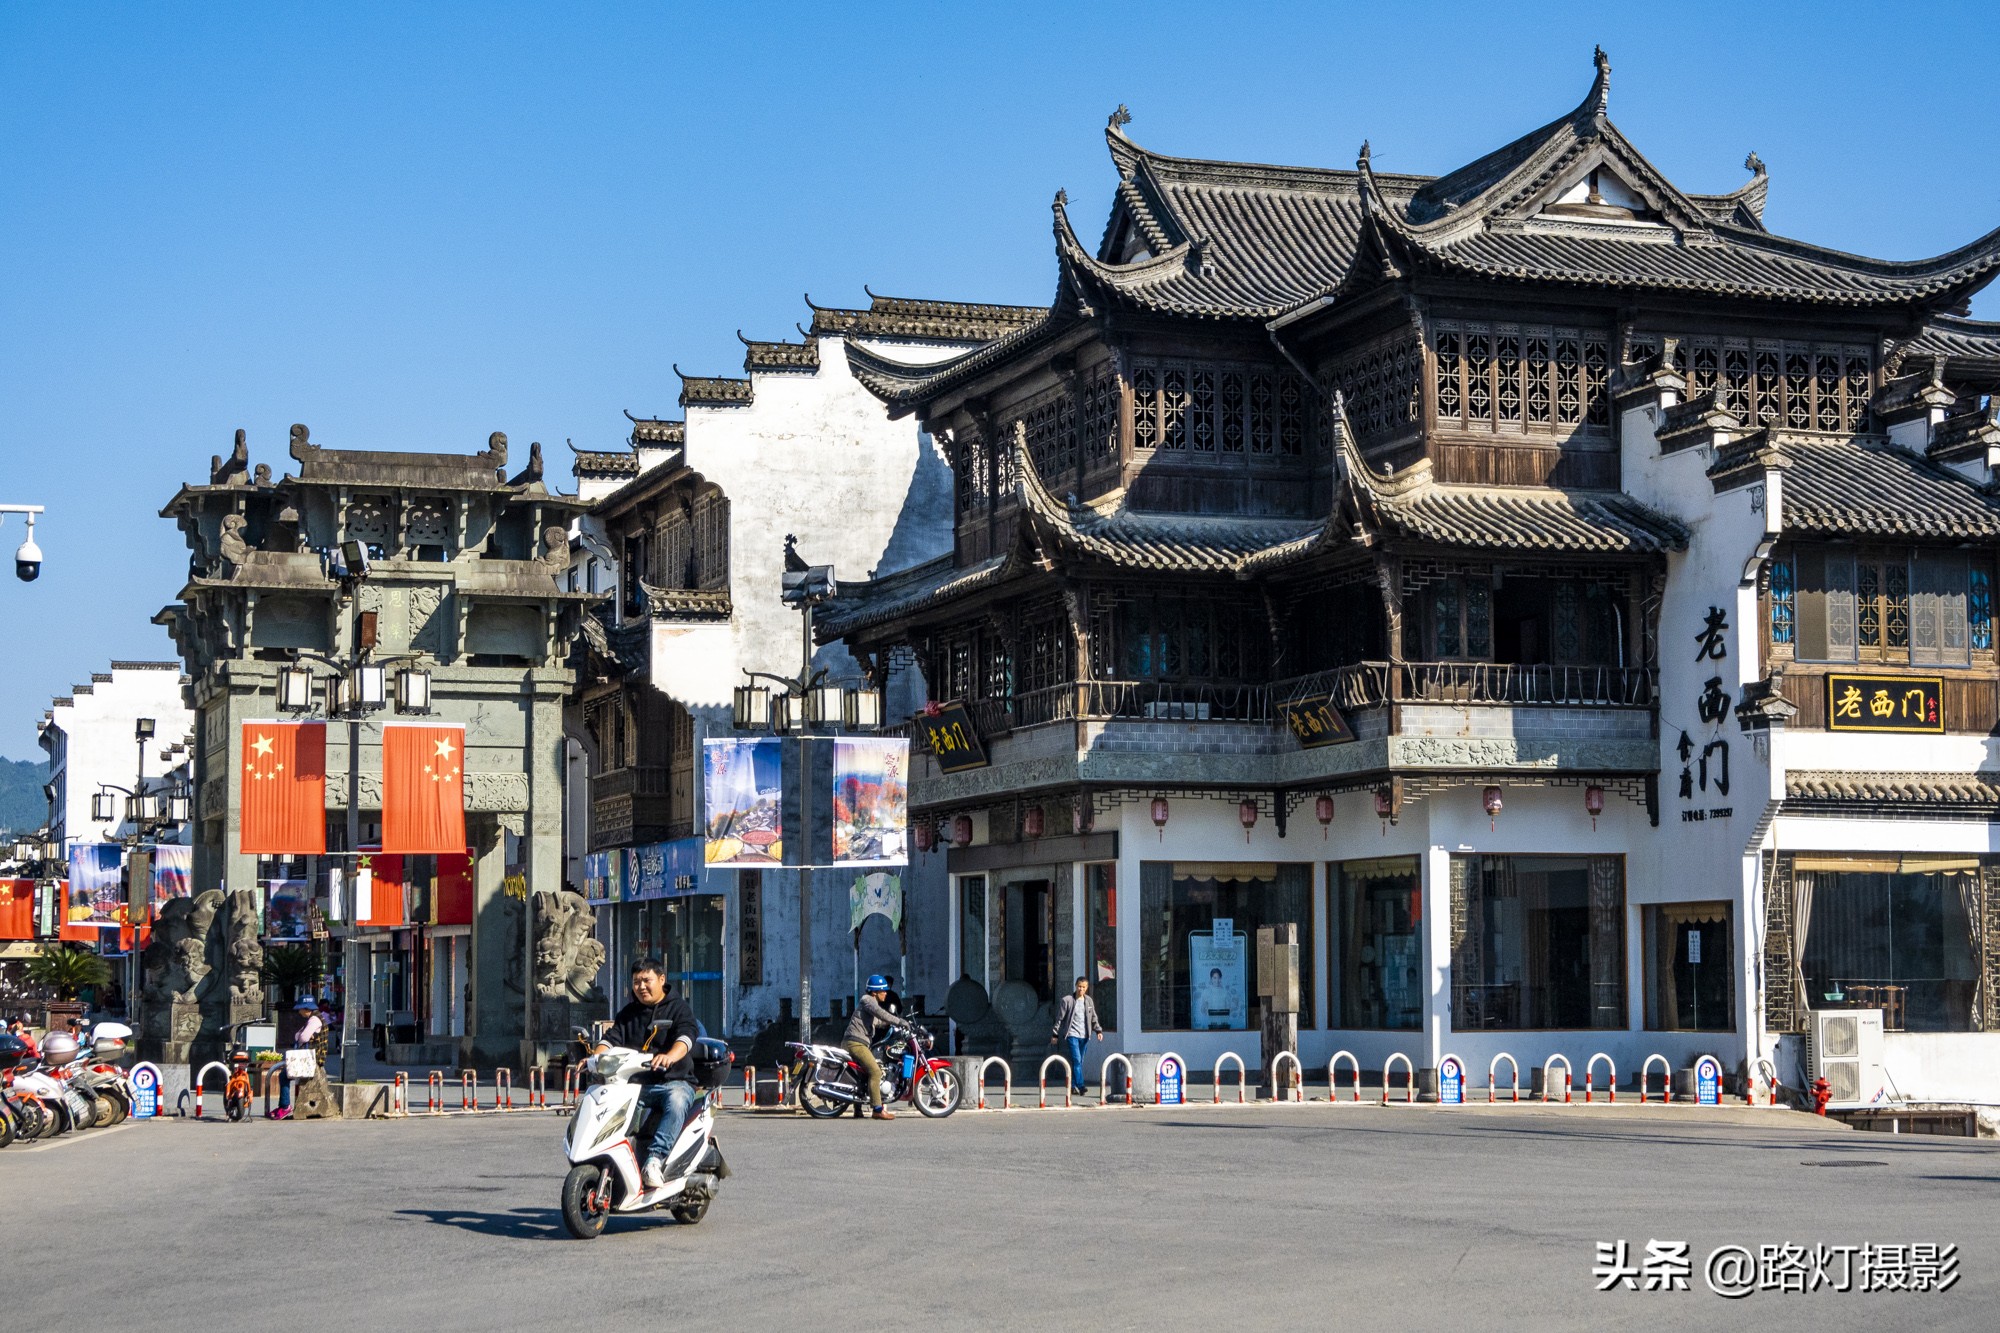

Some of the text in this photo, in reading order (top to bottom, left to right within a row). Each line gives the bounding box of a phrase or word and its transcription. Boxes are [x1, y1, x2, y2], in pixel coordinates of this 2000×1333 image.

[1694, 606, 1731, 796] 老西门
[1836, 685, 1925, 722] 老西门
[928, 722, 970, 755] 老西门
[1290, 706, 1340, 736] 老西门
